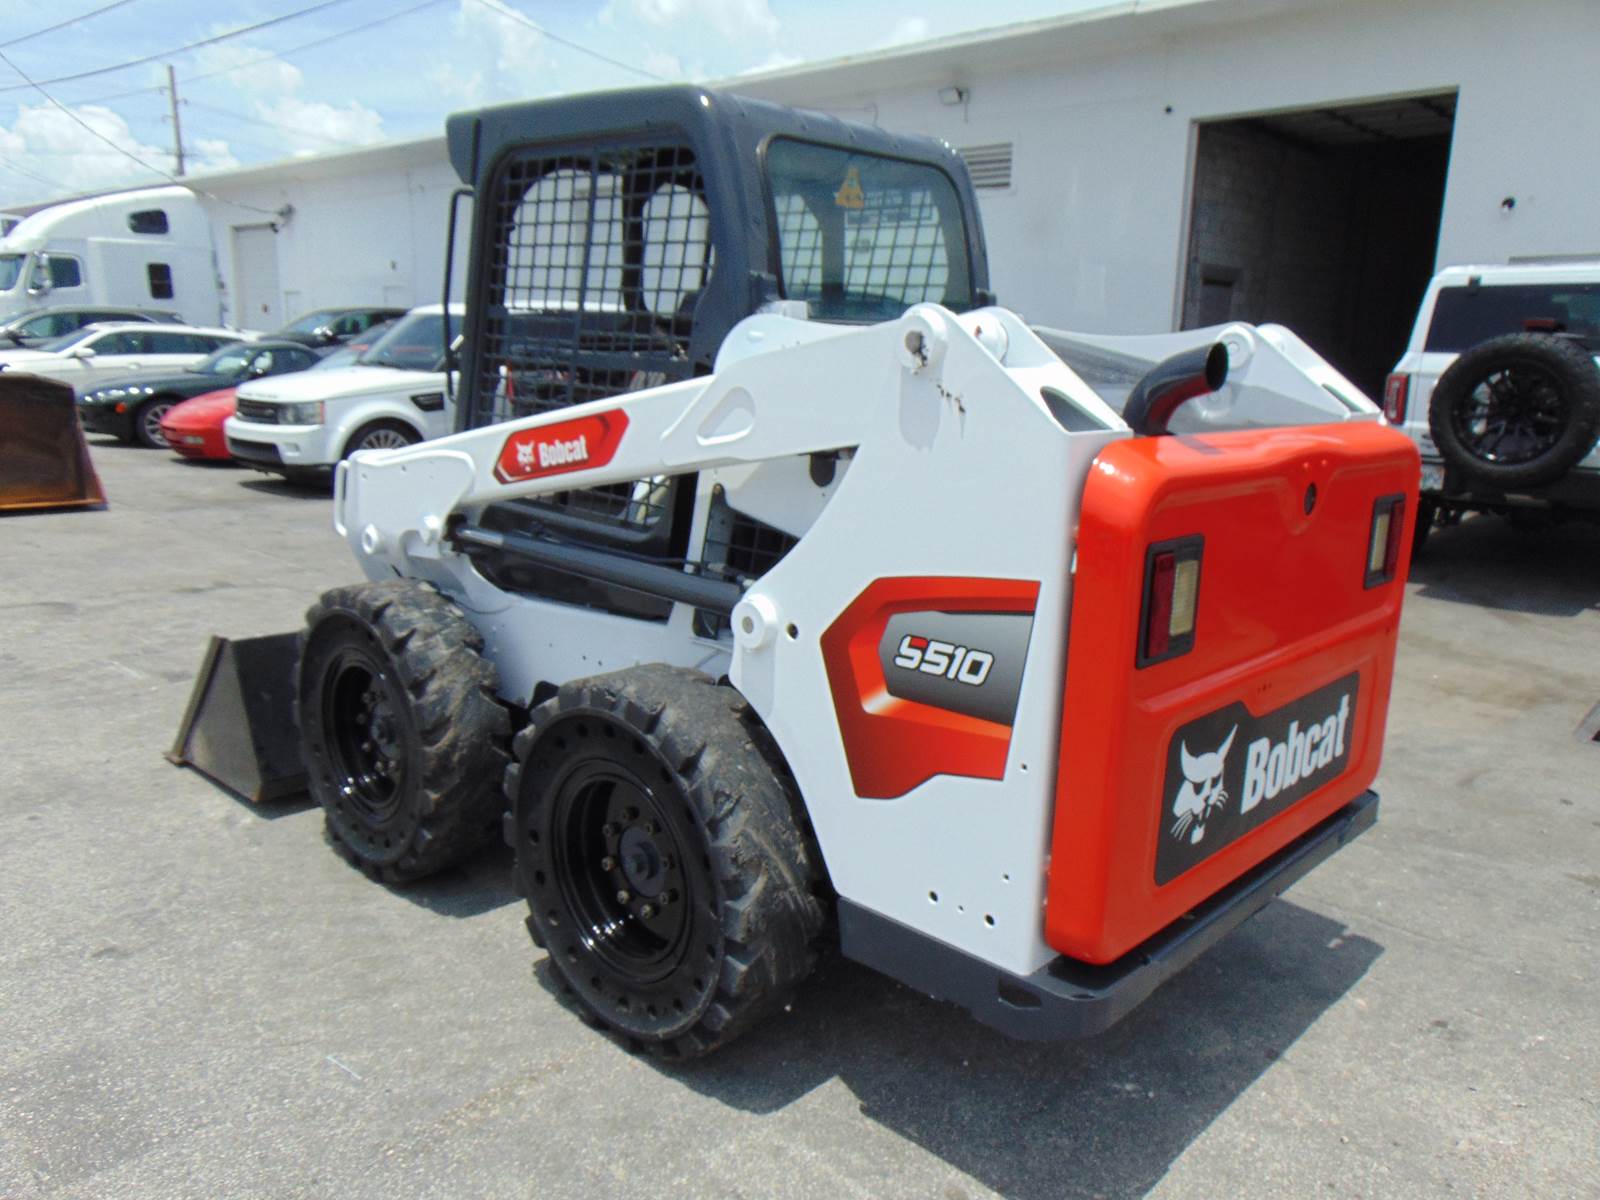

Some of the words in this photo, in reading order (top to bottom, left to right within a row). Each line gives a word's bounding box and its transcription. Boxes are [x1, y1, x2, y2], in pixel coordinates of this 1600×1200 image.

[538, 434, 588, 468] Bobcat
[894, 635, 994, 687] S510
[1240, 694, 1350, 815] Bobcat
